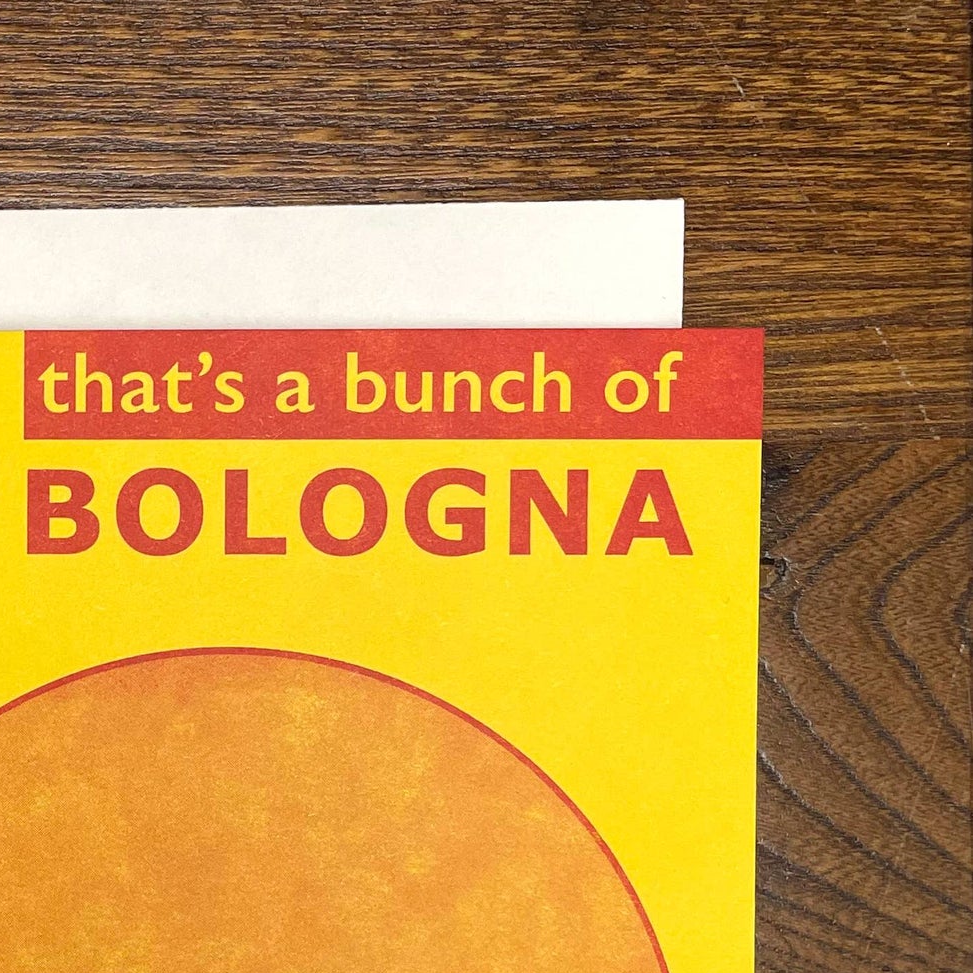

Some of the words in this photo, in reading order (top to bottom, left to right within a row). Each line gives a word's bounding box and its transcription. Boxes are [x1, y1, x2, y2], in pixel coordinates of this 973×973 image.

[37, 350, 246, 414] that’s
[274, 369, 315, 414] a
[344, 350, 573, 415] bunch
[603, 350, 684, 414] of
[26, 466, 694, 557] BOLOGNA
